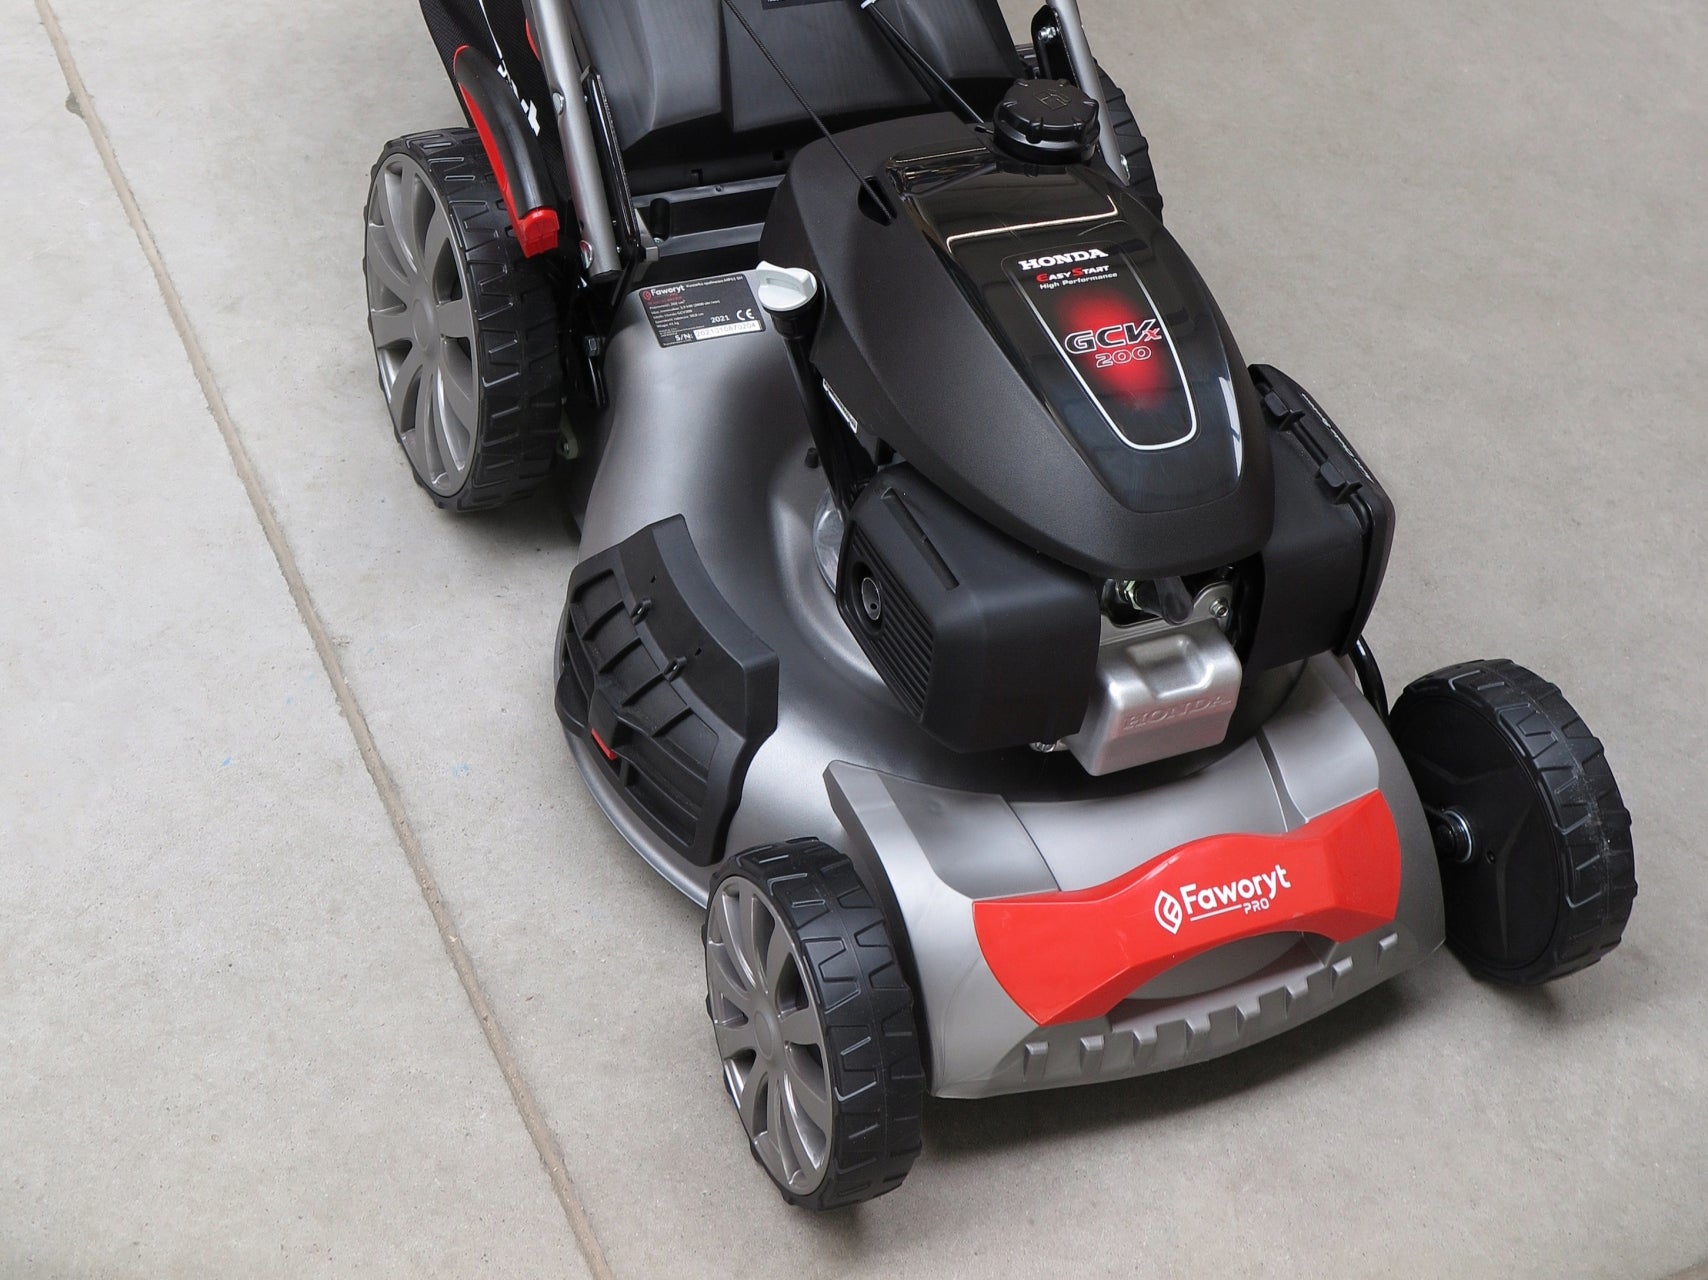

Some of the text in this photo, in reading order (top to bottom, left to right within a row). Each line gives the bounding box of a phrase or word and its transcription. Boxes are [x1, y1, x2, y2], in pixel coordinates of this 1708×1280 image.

[1018, 248, 1109, 270] HONDA
[1039, 272, 1118, 290] High Performance
[650, 284, 685, 297] Faworyt
[710, 315, 730, 324] 2021
[736, 308, 755, 321] CE
[675, 333, 693, 341] S/N:
[1095, 345, 1152, 368] 200
[1123, 696, 1232, 731] HONDA
[1180, 864, 1291, 915] Faworyt
[1243, 897, 1270, 915] PRO
